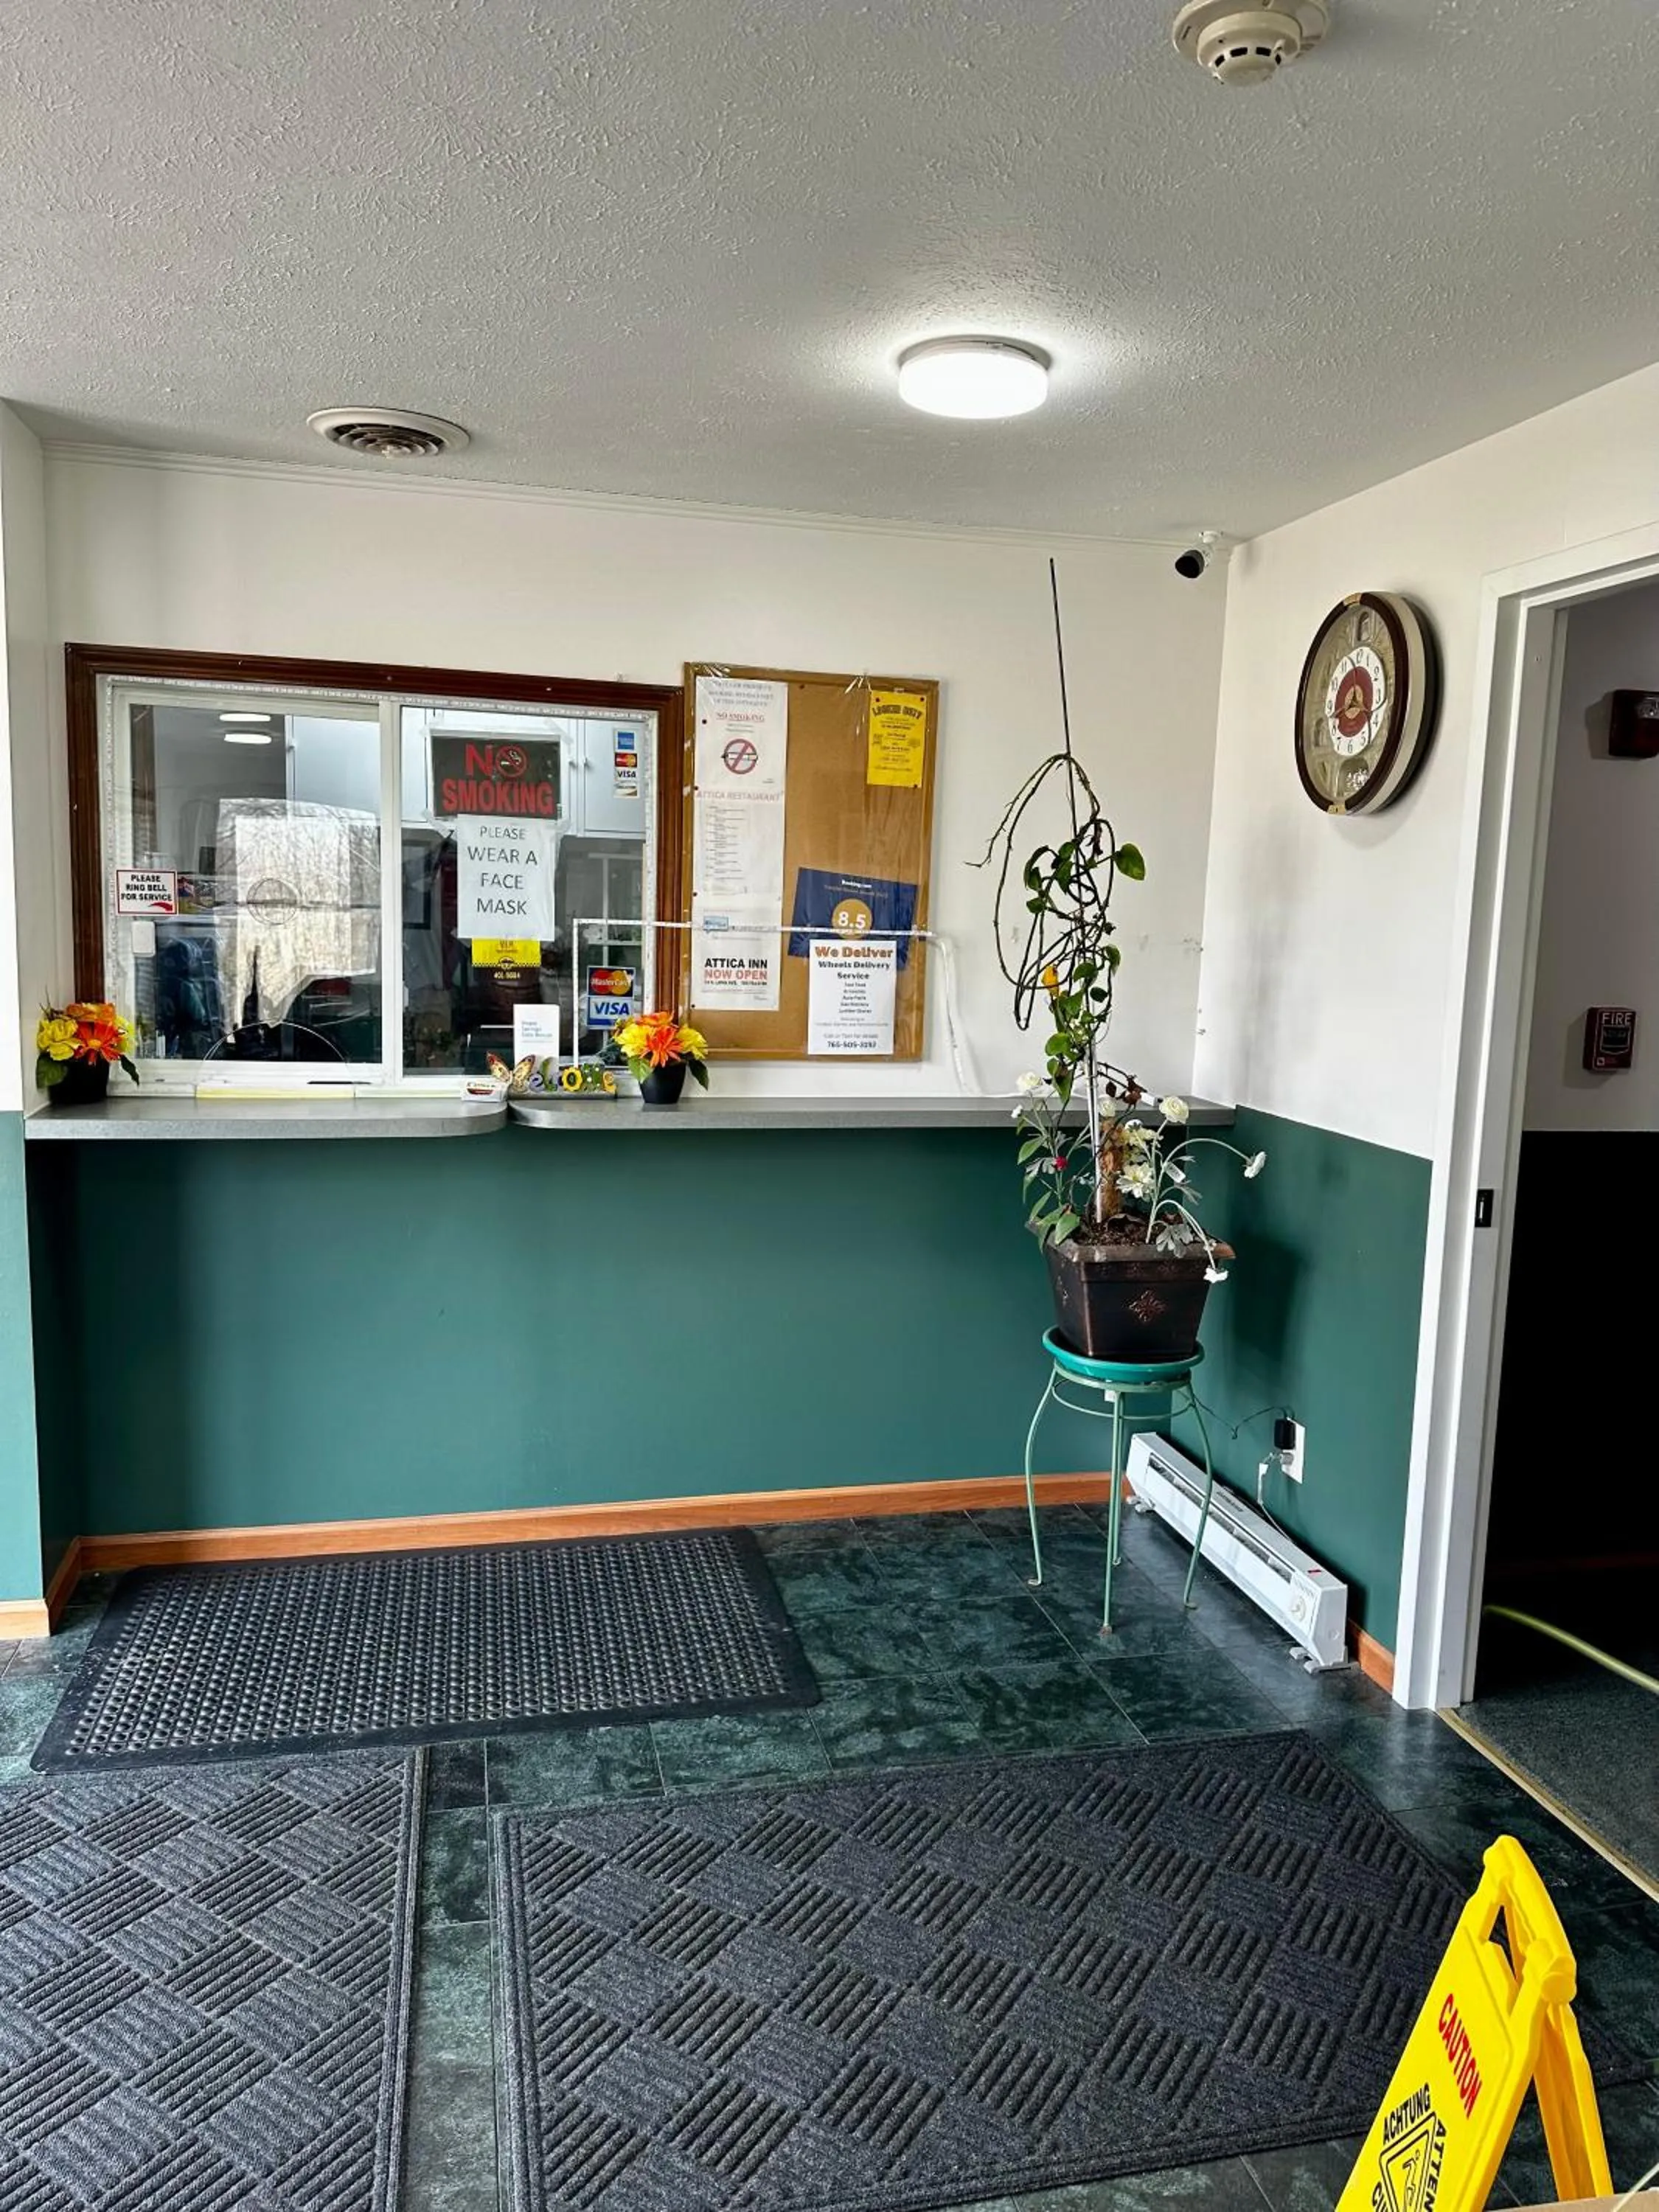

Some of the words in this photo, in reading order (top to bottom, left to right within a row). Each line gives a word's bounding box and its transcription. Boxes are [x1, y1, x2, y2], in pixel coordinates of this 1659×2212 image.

[442, 779, 553, 814] SMOKING
[727, 792, 780, 801] RESTAURANT
[479, 826, 526, 840] PLEASE
[467, 846, 520, 864] WEAR
[526, 851, 538, 866] A
[131, 874, 161, 883] PLEASE
[481, 872, 524, 890] FACE
[138, 893, 172, 901] SERVICE
[476, 898, 527, 915] MASK
[838, 911, 866, 928] 8.5
[815, 946, 838, 958] We
[842, 946, 893, 958] Deliver
[705, 958, 745, 968] ATTICA
[748, 959, 768, 969] INN
[854, 961, 890, 970] Delivery
[704, 970, 731, 978] NOW
[736, 970, 768, 979] OPEN
[595, 1002, 629, 1015] VISA
[1602, 1012, 1632, 1025] FIRE
[1439, 1993, 1482, 2120] CAUTION
[1383, 2081, 1430, 2145] ACHTUNG
